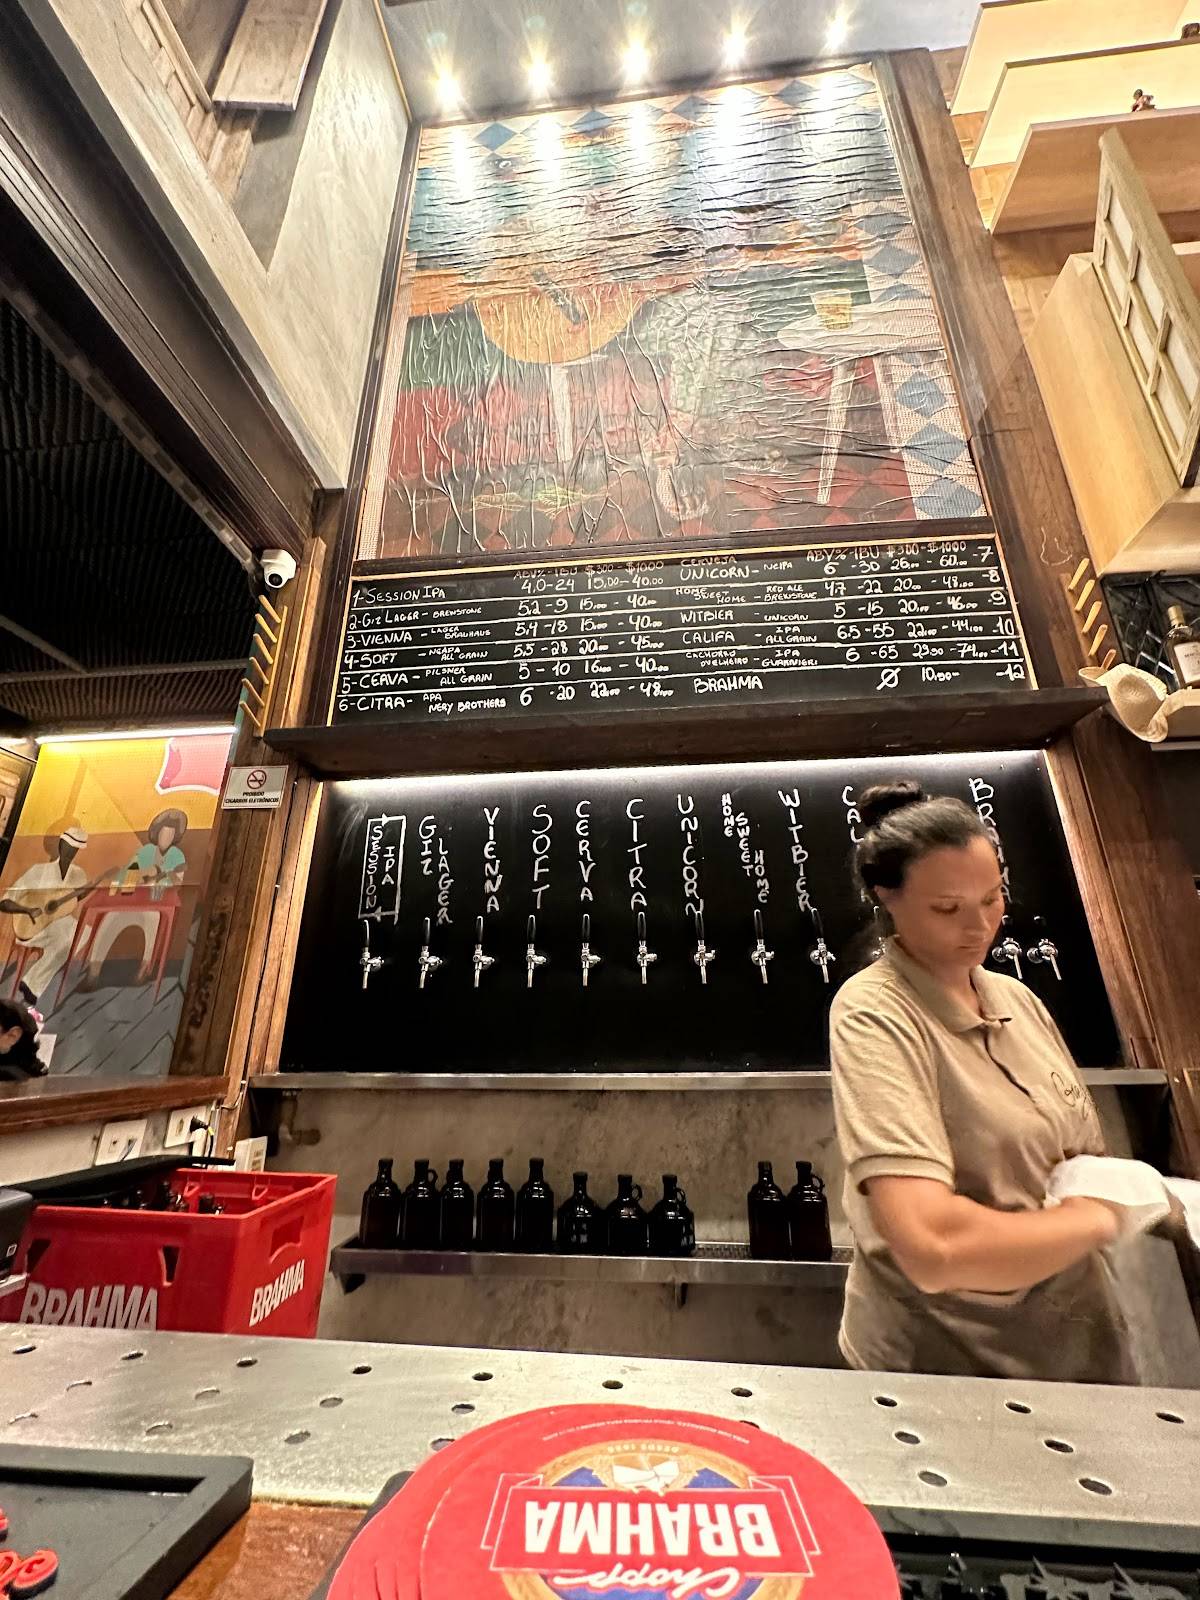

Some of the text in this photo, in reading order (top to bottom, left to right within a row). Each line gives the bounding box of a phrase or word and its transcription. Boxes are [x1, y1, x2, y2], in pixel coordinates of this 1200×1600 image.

[764, 562, 793, 571] NEIPA
[824, 562, 839, 575] 6
[423, 586, 445, 598] IPA
[695, 590, 729, 600] SWEET
[718, 596, 746, 604] HOME
[766, 584, 803, 593] RED ALE
[433, 608, 481, 619] BREWSTONE
[680, 610, 734, 624] WITBIER
[764, 613, 808, 621] UNICORN
[834, 602, 845, 618] 5
[445, 630, 490, 639] BRAUHAUS
[683, 630, 735, 644] CALIFA
[776, 626, 800, 634] IPA
[786, 635, 817, 643] GRAIN
[441, 652, 454, 661] ALL
[459, 650, 488, 659] GRAIN
[686, 650, 736, 658] CACHORRO
[701, 657, 748, 667] OVELHEIRO
[775, 649, 800, 657] IPA
[846, 647, 860, 661] 6
[425, 667, 466, 677] PILSNER
[440, 676, 456, 686] ALL
[460, 673, 493, 684] GRAIN
[519, 663, 530, 680] 5
[694, 675, 763, 693] BRAHMA
[423, 693, 442, 702] APA
[429, 701, 453, 715] NERY
[458, 698, 506, 711] BROTHERS
[520, 687, 533, 705] 6
[575, 799, 596, 902] CERVA
[626, 798, 648, 911] CITRA
[735, 812, 752, 877] SWEET
[777, 788, 813, 912] WITBIER
[381, 845, 395, 886] IPA
[483, 806, 503, 914] VIENNA
[531, 804, 553, 910] SOFT
[676, 794, 705, 917] UNICORN
[366, 825, 384, 909] SESSION
[754, 850, 770, 904] HOME
[436, 838, 454, 926] LAGER
[249, 1259, 305, 1327] BRAHMA
[19, 1282, 158, 1331] BRAHMA
[524, 1499, 782, 1558] BRAHMA
[552, 1561, 740, 1600] Chopp
